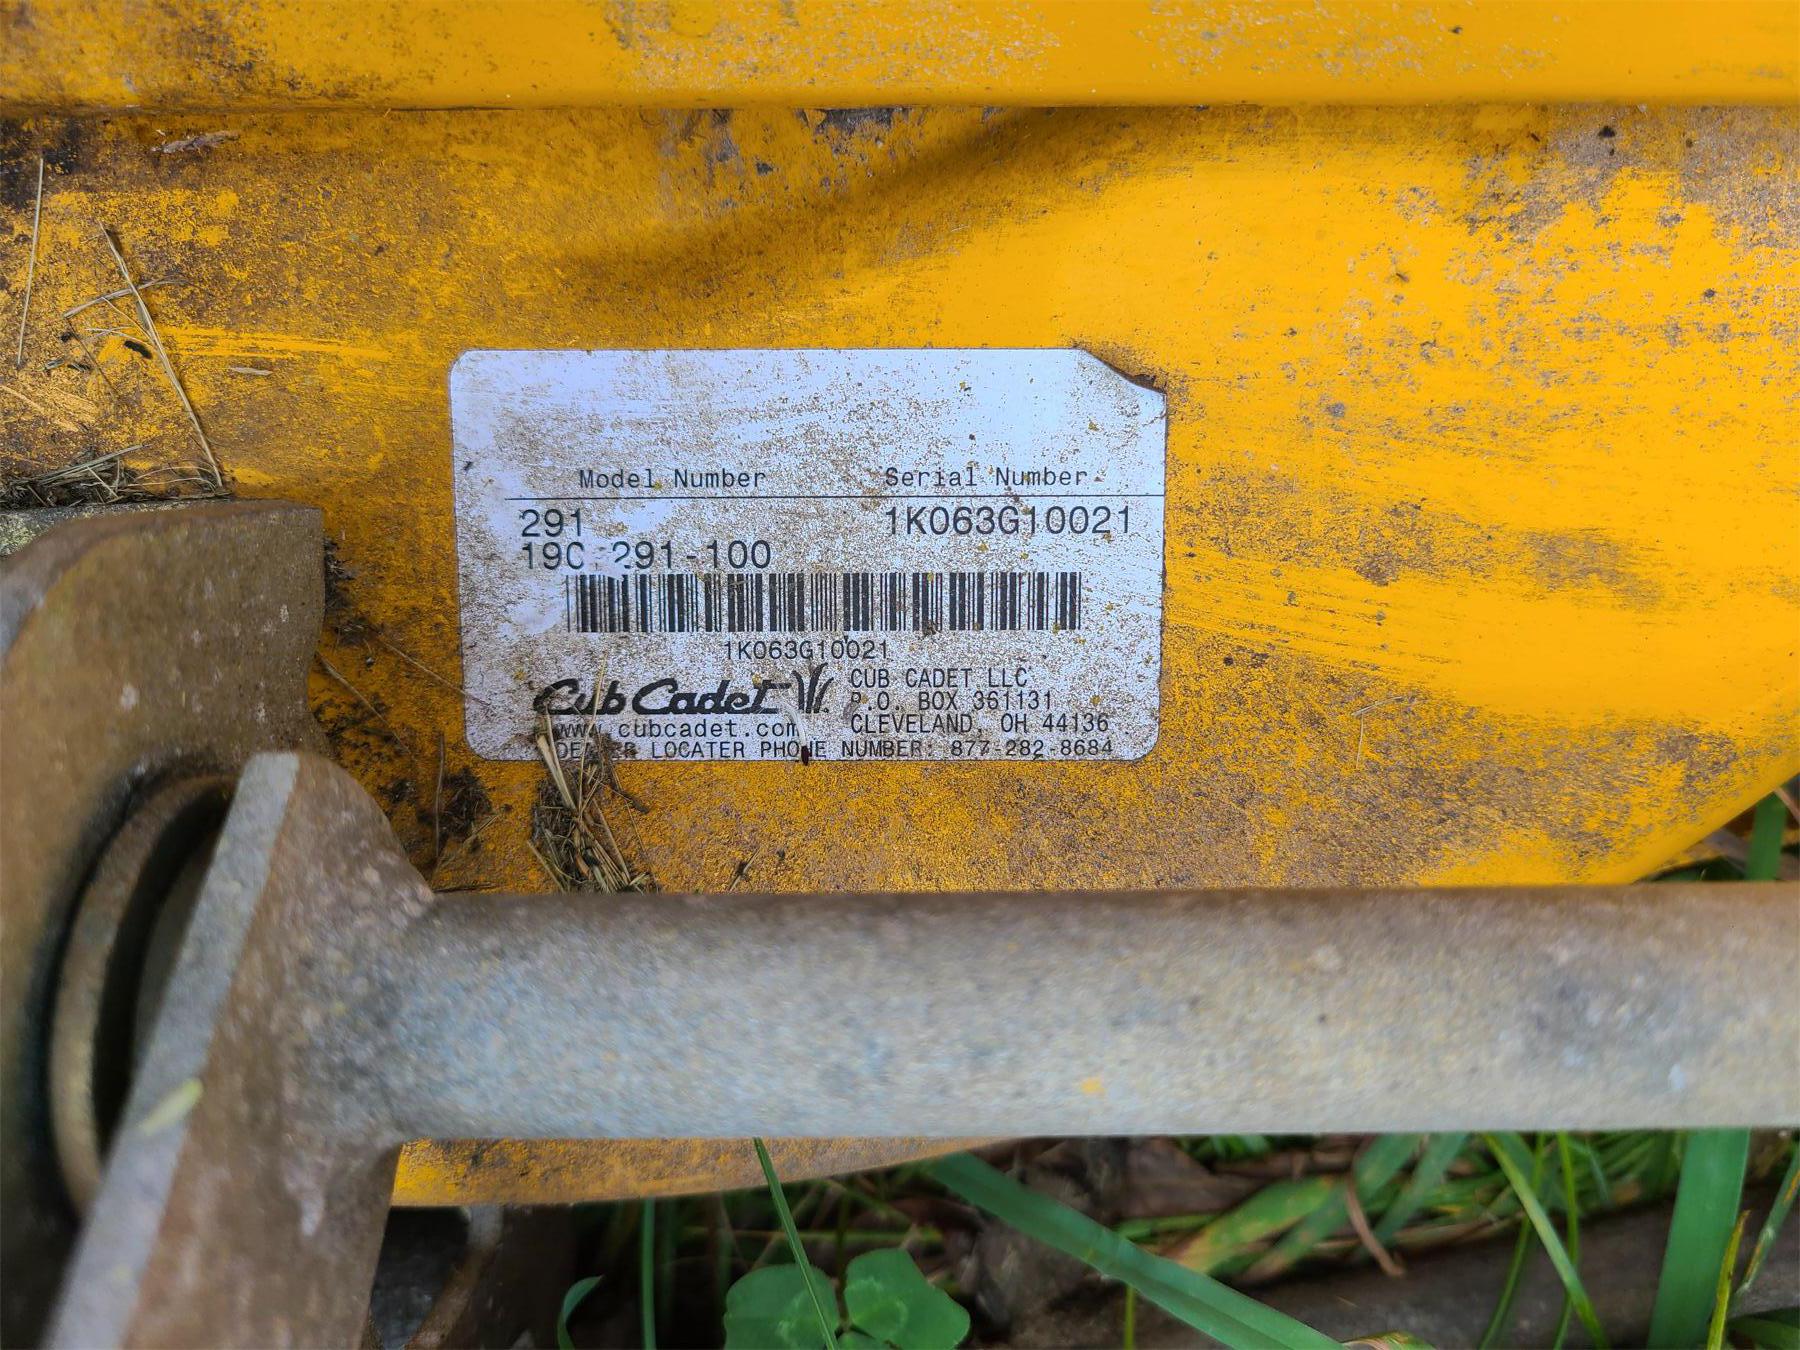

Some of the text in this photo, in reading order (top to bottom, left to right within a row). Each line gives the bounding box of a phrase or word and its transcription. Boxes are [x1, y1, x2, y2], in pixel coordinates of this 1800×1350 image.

[579, 468, 766, 488] Model Number
[885, 467, 1088, 487] Serial Number
[520, 508, 582, 538] 291
[885, 504, 1130, 535] 1K063G10021
[724, 640, 888, 661] 1K063G10021
[850, 667, 1028, 688] CUB CADET LLC
[533, 677, 790, 716] Cub Cadet
[850, 690, 1053, 712] P.O. BOX 361131
[555, 718, 801, 738] wwwcubcadet.com
[850, 712, 1110, 737] CLEVELAND, OH 44136
[651, 740, 746, 759] LOCATER
[841, 739, 934, 758] NUMBER:
[950, 739, 1114, 758] 877-282-8684
